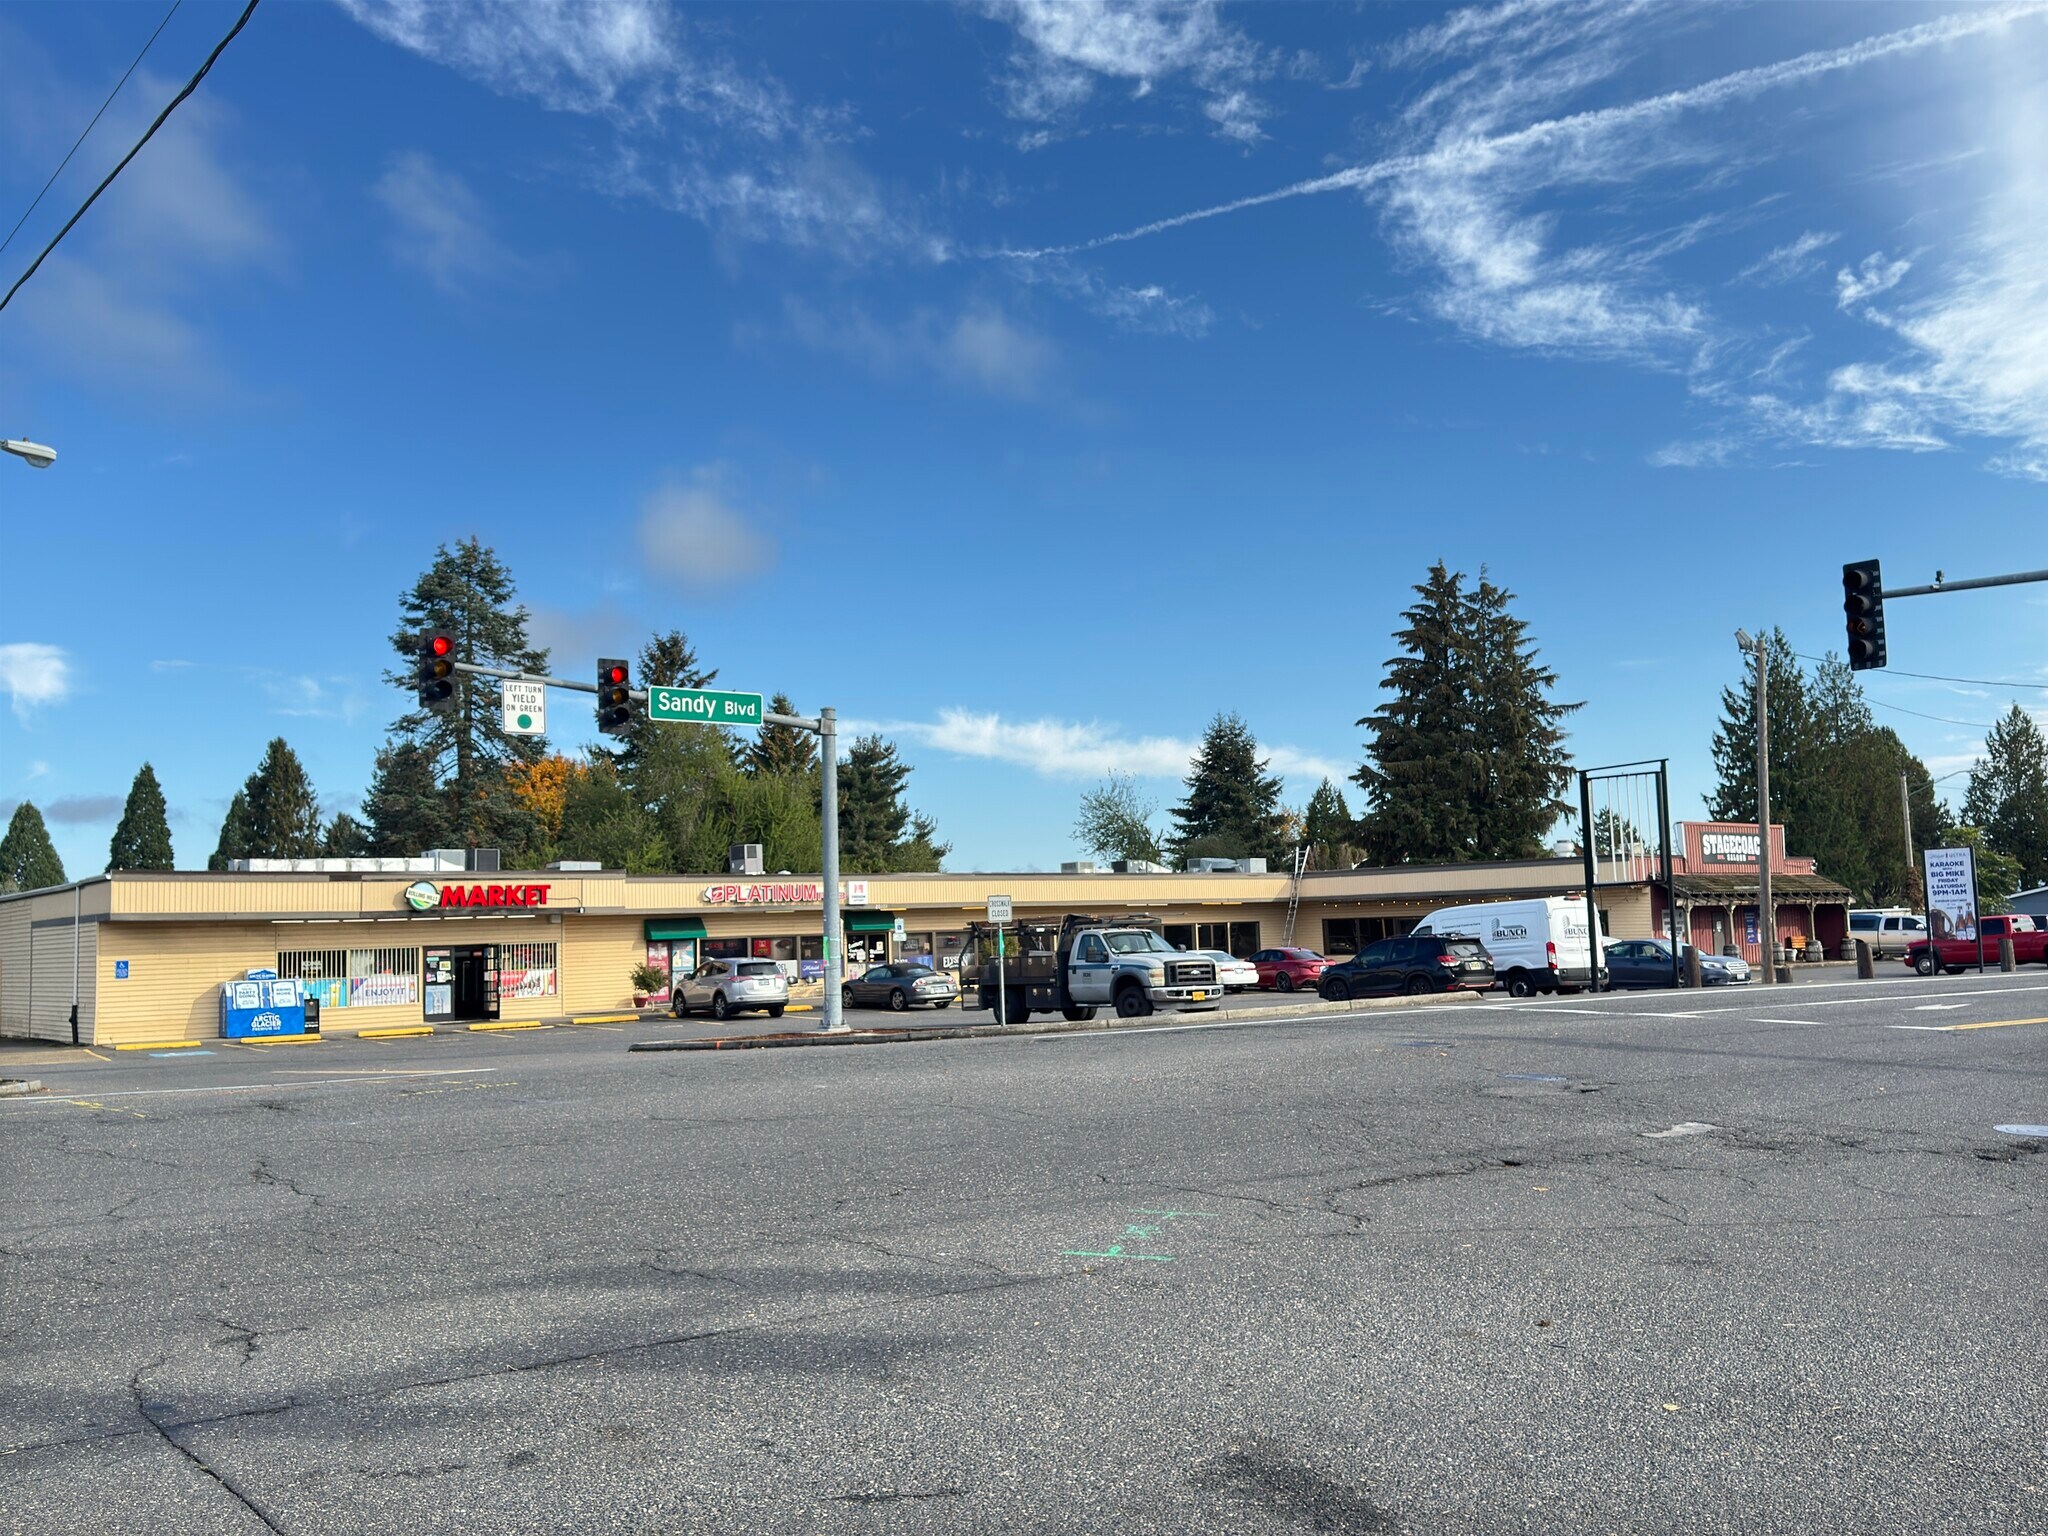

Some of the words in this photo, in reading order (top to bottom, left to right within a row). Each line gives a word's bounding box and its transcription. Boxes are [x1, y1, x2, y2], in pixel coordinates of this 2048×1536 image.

[505, 684, 521, 692] LEFT
[512, 694, 536, 703] YIELD
[520, 704, 542, 712] GREEN
[658, 692, 716, 718] Sandy
[724, 700, 755, 716] Blvd
[1702, 834, 1760, 855] STAGECOAC
[441, 884, 551, 907] MARKET
[723, 884, 817, 903] PLATINUM
[992, 909, 1008, 917] CLOSED
[1496, 928, 1527, 937] BUNCH
[365, 988, 394, 996] ENJOY
[398, 987, 405, 995] IT
[251, 1020, 281, 1028] GLACIER
